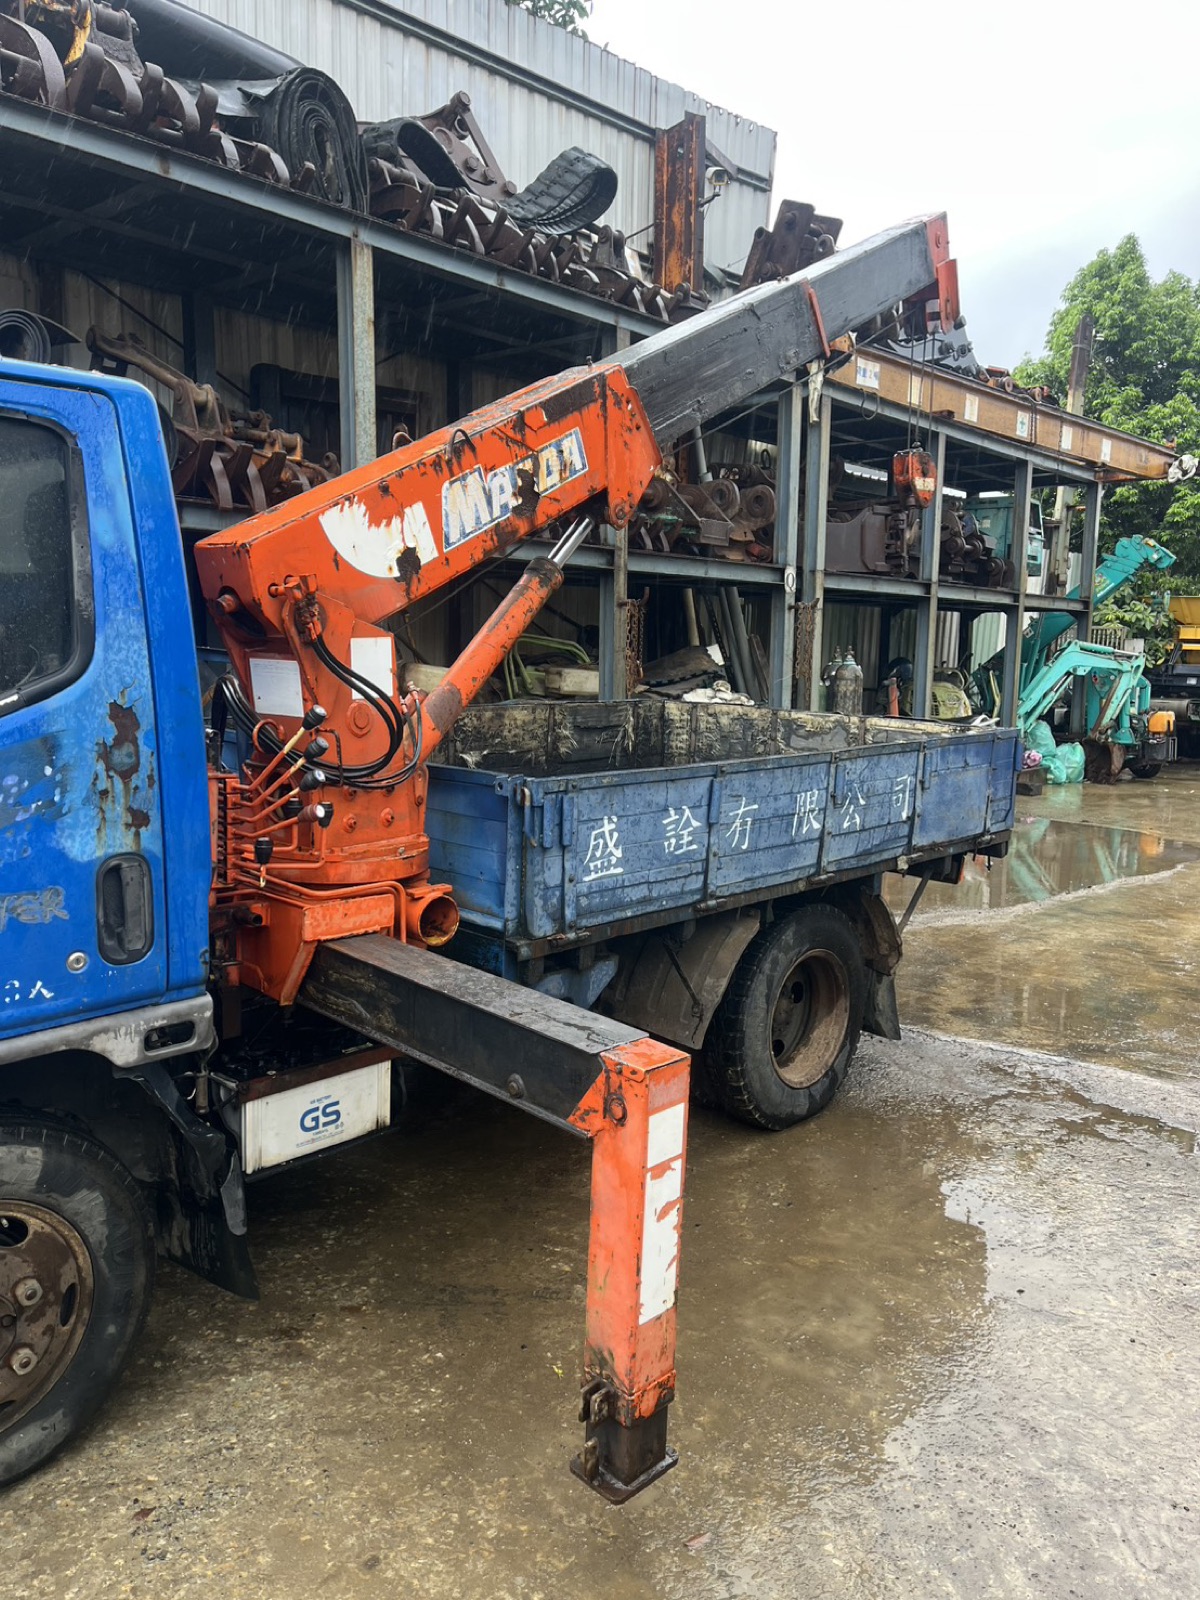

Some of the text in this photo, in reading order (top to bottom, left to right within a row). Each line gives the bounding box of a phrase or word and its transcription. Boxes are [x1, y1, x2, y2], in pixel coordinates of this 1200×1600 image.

[582, 774, 911, 882] 盛詮有限公司
[299, 1100, 342, 1133] GS
